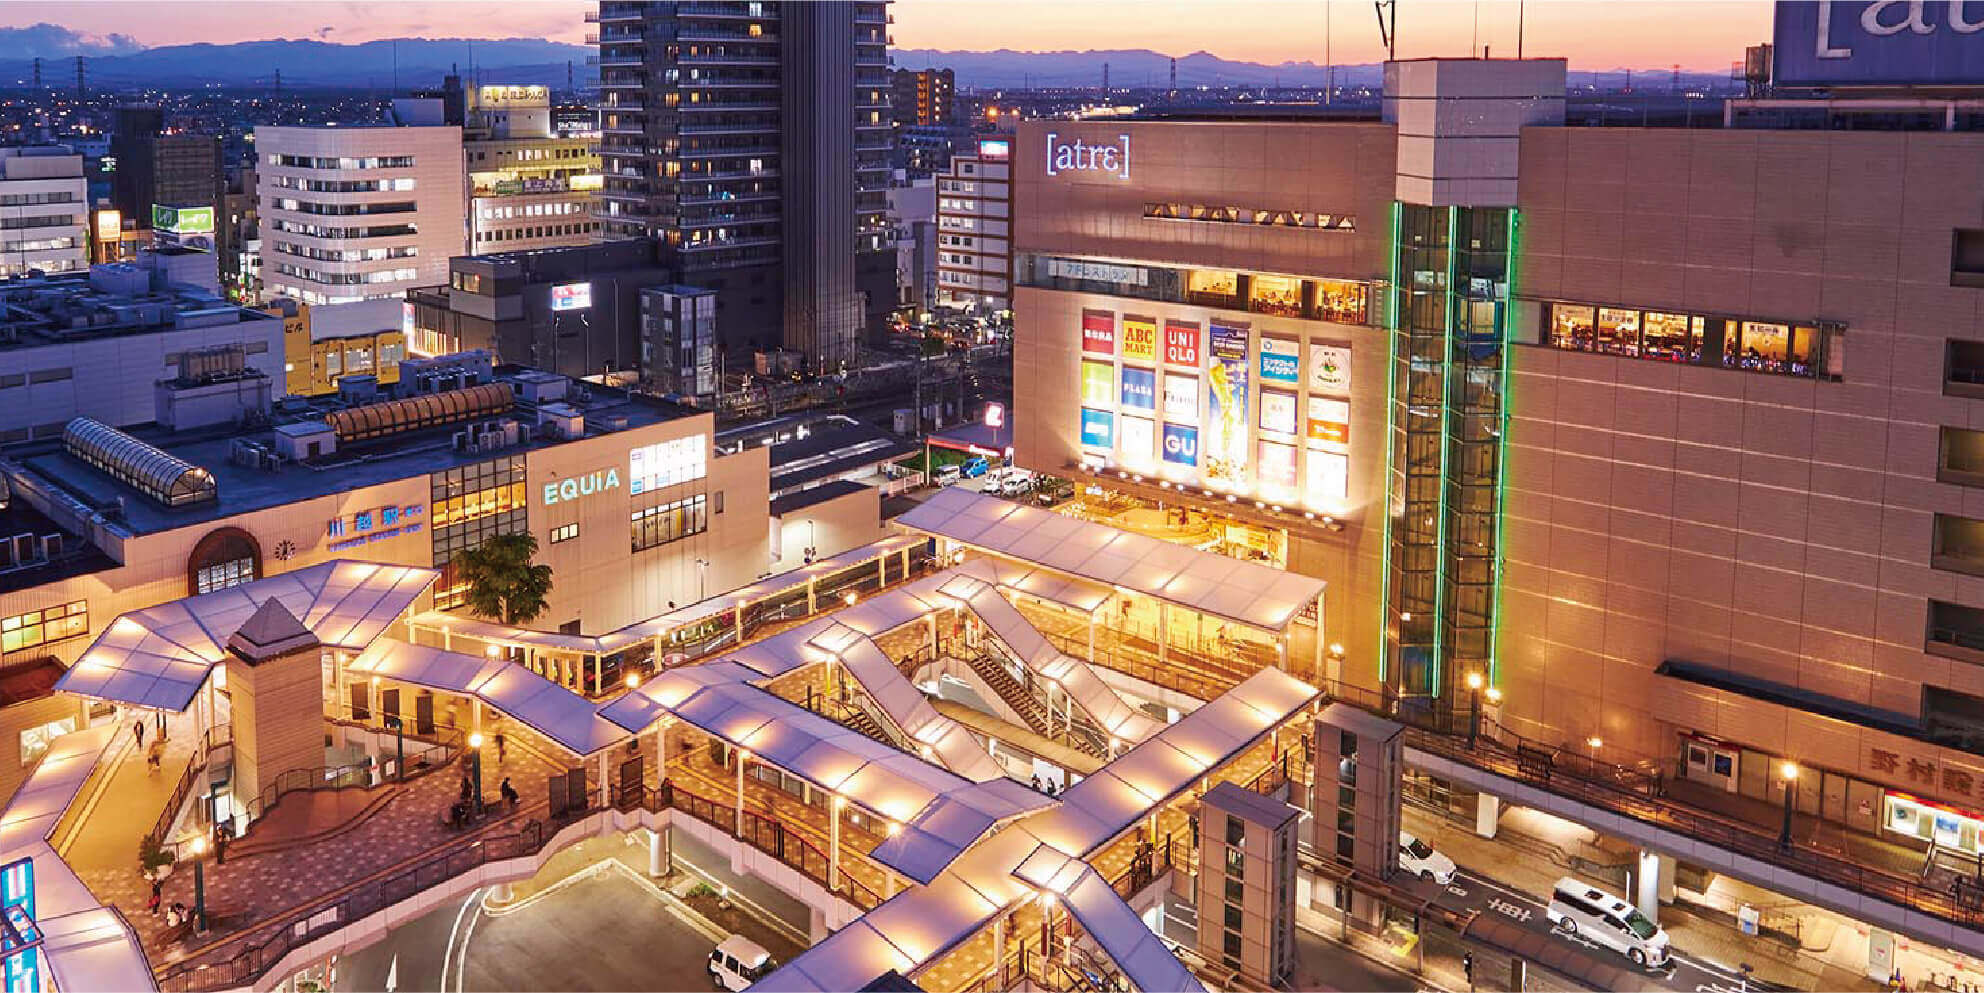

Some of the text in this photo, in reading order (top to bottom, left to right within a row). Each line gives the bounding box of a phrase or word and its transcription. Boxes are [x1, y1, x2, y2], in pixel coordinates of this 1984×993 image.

[1125, 327, 1153, 344] ABC
[1168, 331, 1194, 347] UNI
[1125, 343, 1153, 356] MART
[1168, 347, 1195, 362] QLO
[1165, 434, 1196, 456] GU
